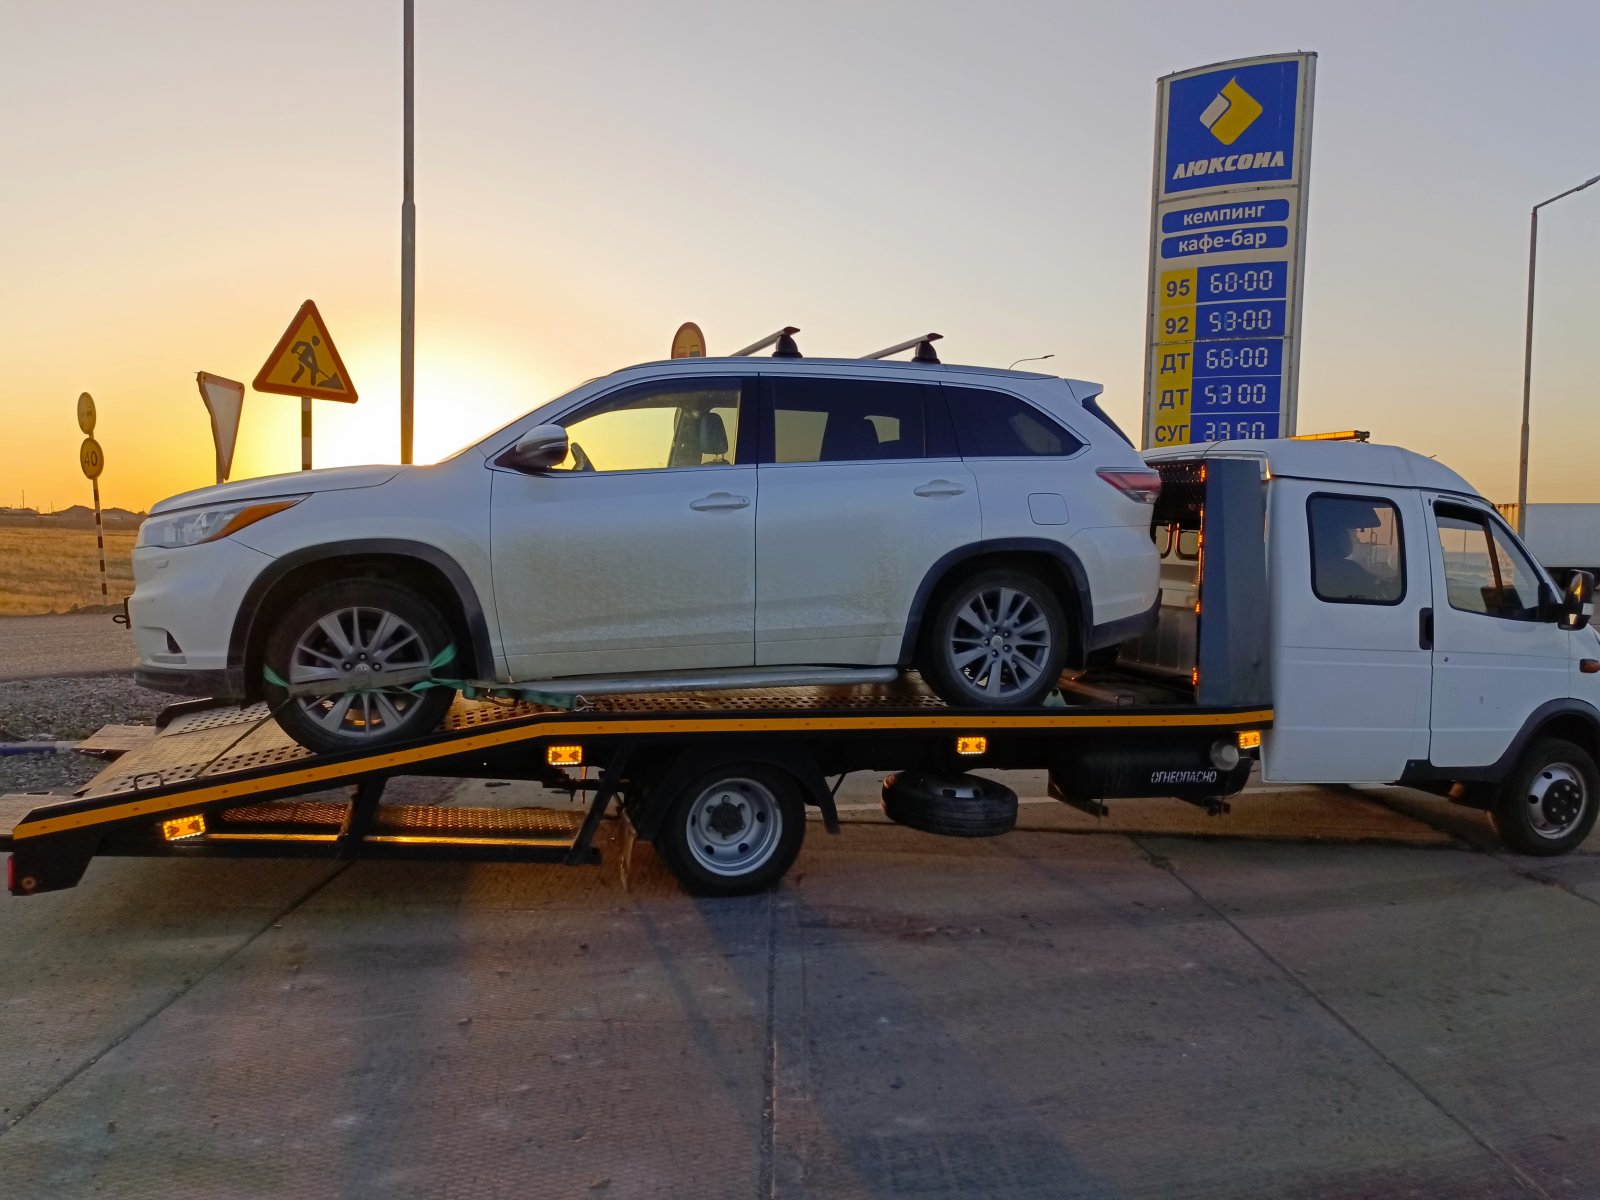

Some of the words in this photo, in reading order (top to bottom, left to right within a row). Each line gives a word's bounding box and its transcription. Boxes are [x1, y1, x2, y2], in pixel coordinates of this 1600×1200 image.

[1172, 151, 1285, 180] ЛЮКСОИЛ
[1183, 205, 1265, 226] кемпинг
[1178, 230, 1267, 253] кафе-бар
[1166, 279, 1190, 298] 95
[1165, 316, 1189, 335] 92
[1160, 352, 1190, 375] ДТ
[1158, 388, 1189, 410] ДТ
[1155, 424, 1189, 443] СУГ
[84, 451, 98, 466] 40
[1151, 771, 1217, 783] ОГНЕОПАСНО
